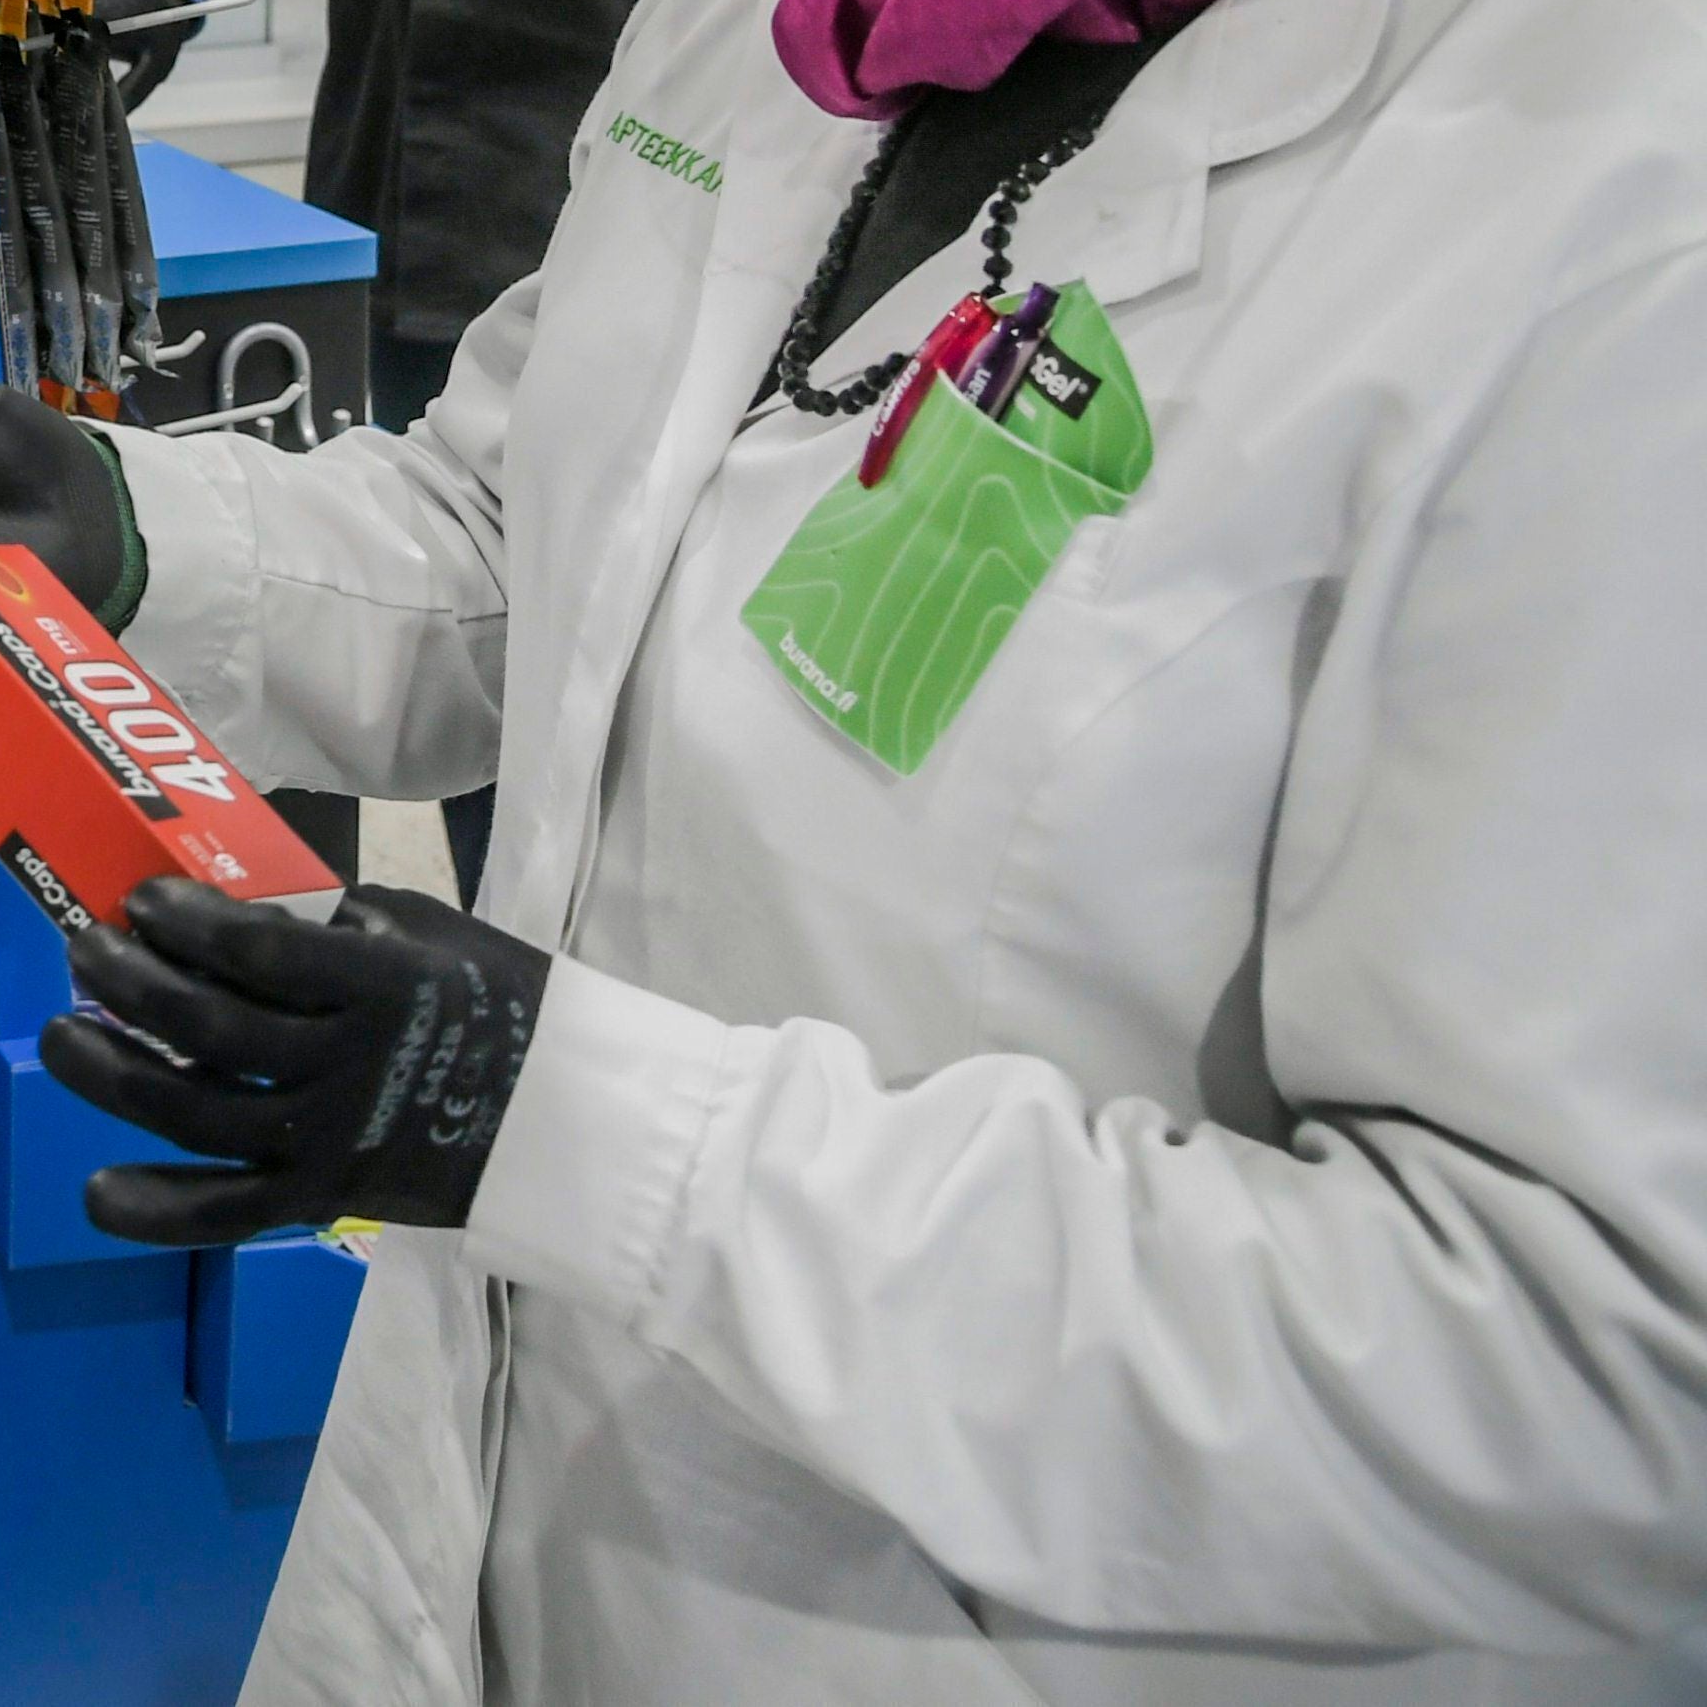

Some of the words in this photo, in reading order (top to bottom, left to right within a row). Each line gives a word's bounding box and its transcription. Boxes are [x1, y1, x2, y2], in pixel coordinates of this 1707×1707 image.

[34, 616, 78, 656] mg
[779, 629, 858, 713] burana.fi
[64, 661, 236, 802] 400
[16, 848, 92, 929] a-Caps
